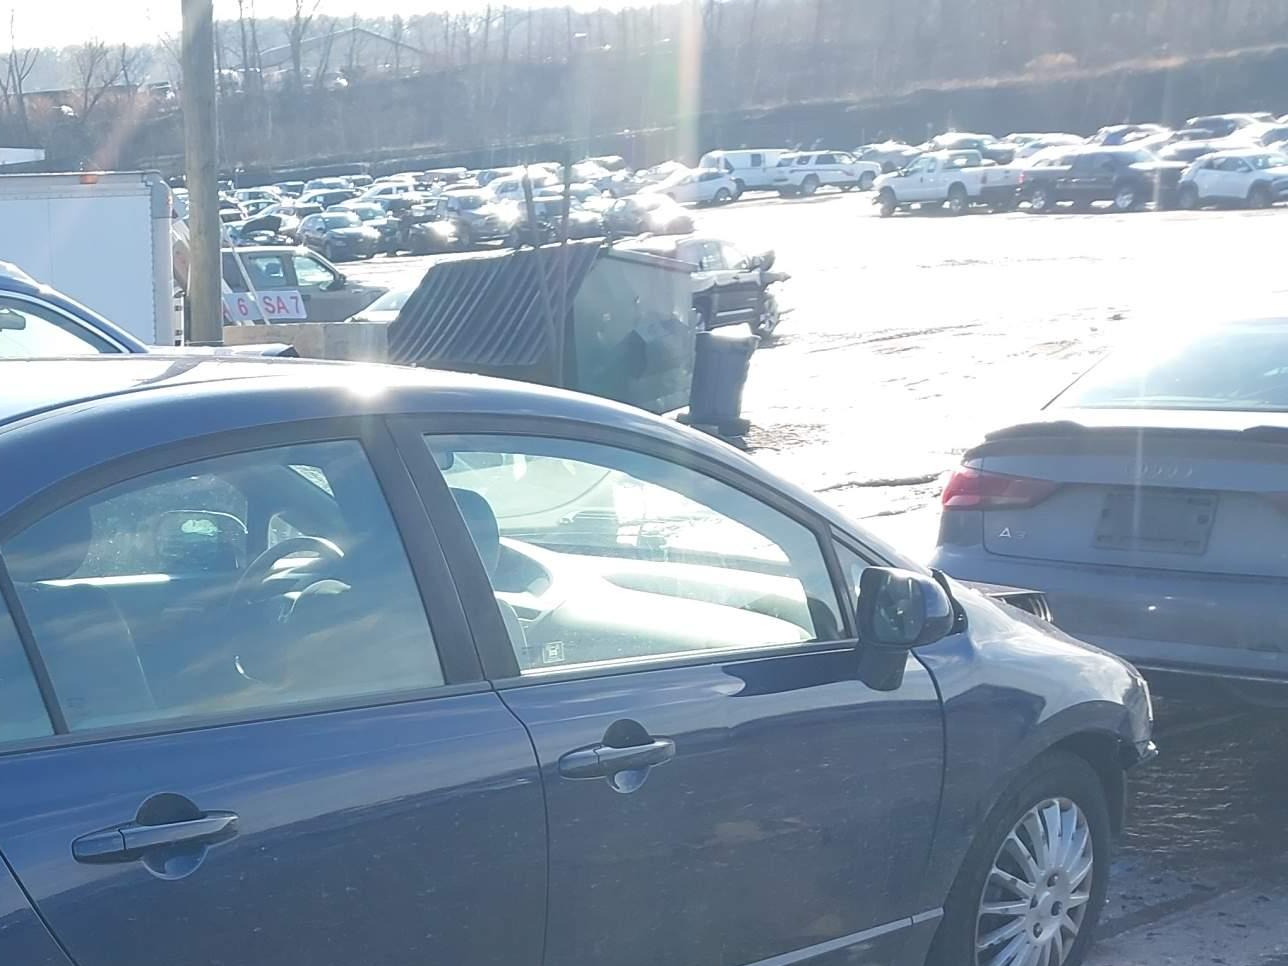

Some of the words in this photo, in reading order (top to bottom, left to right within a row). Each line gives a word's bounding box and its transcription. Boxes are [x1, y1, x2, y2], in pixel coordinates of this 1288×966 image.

[237, 298, 249, 316] 6
[262, 296, 289, 314] SA
[290, 296, 300, 314] 7
